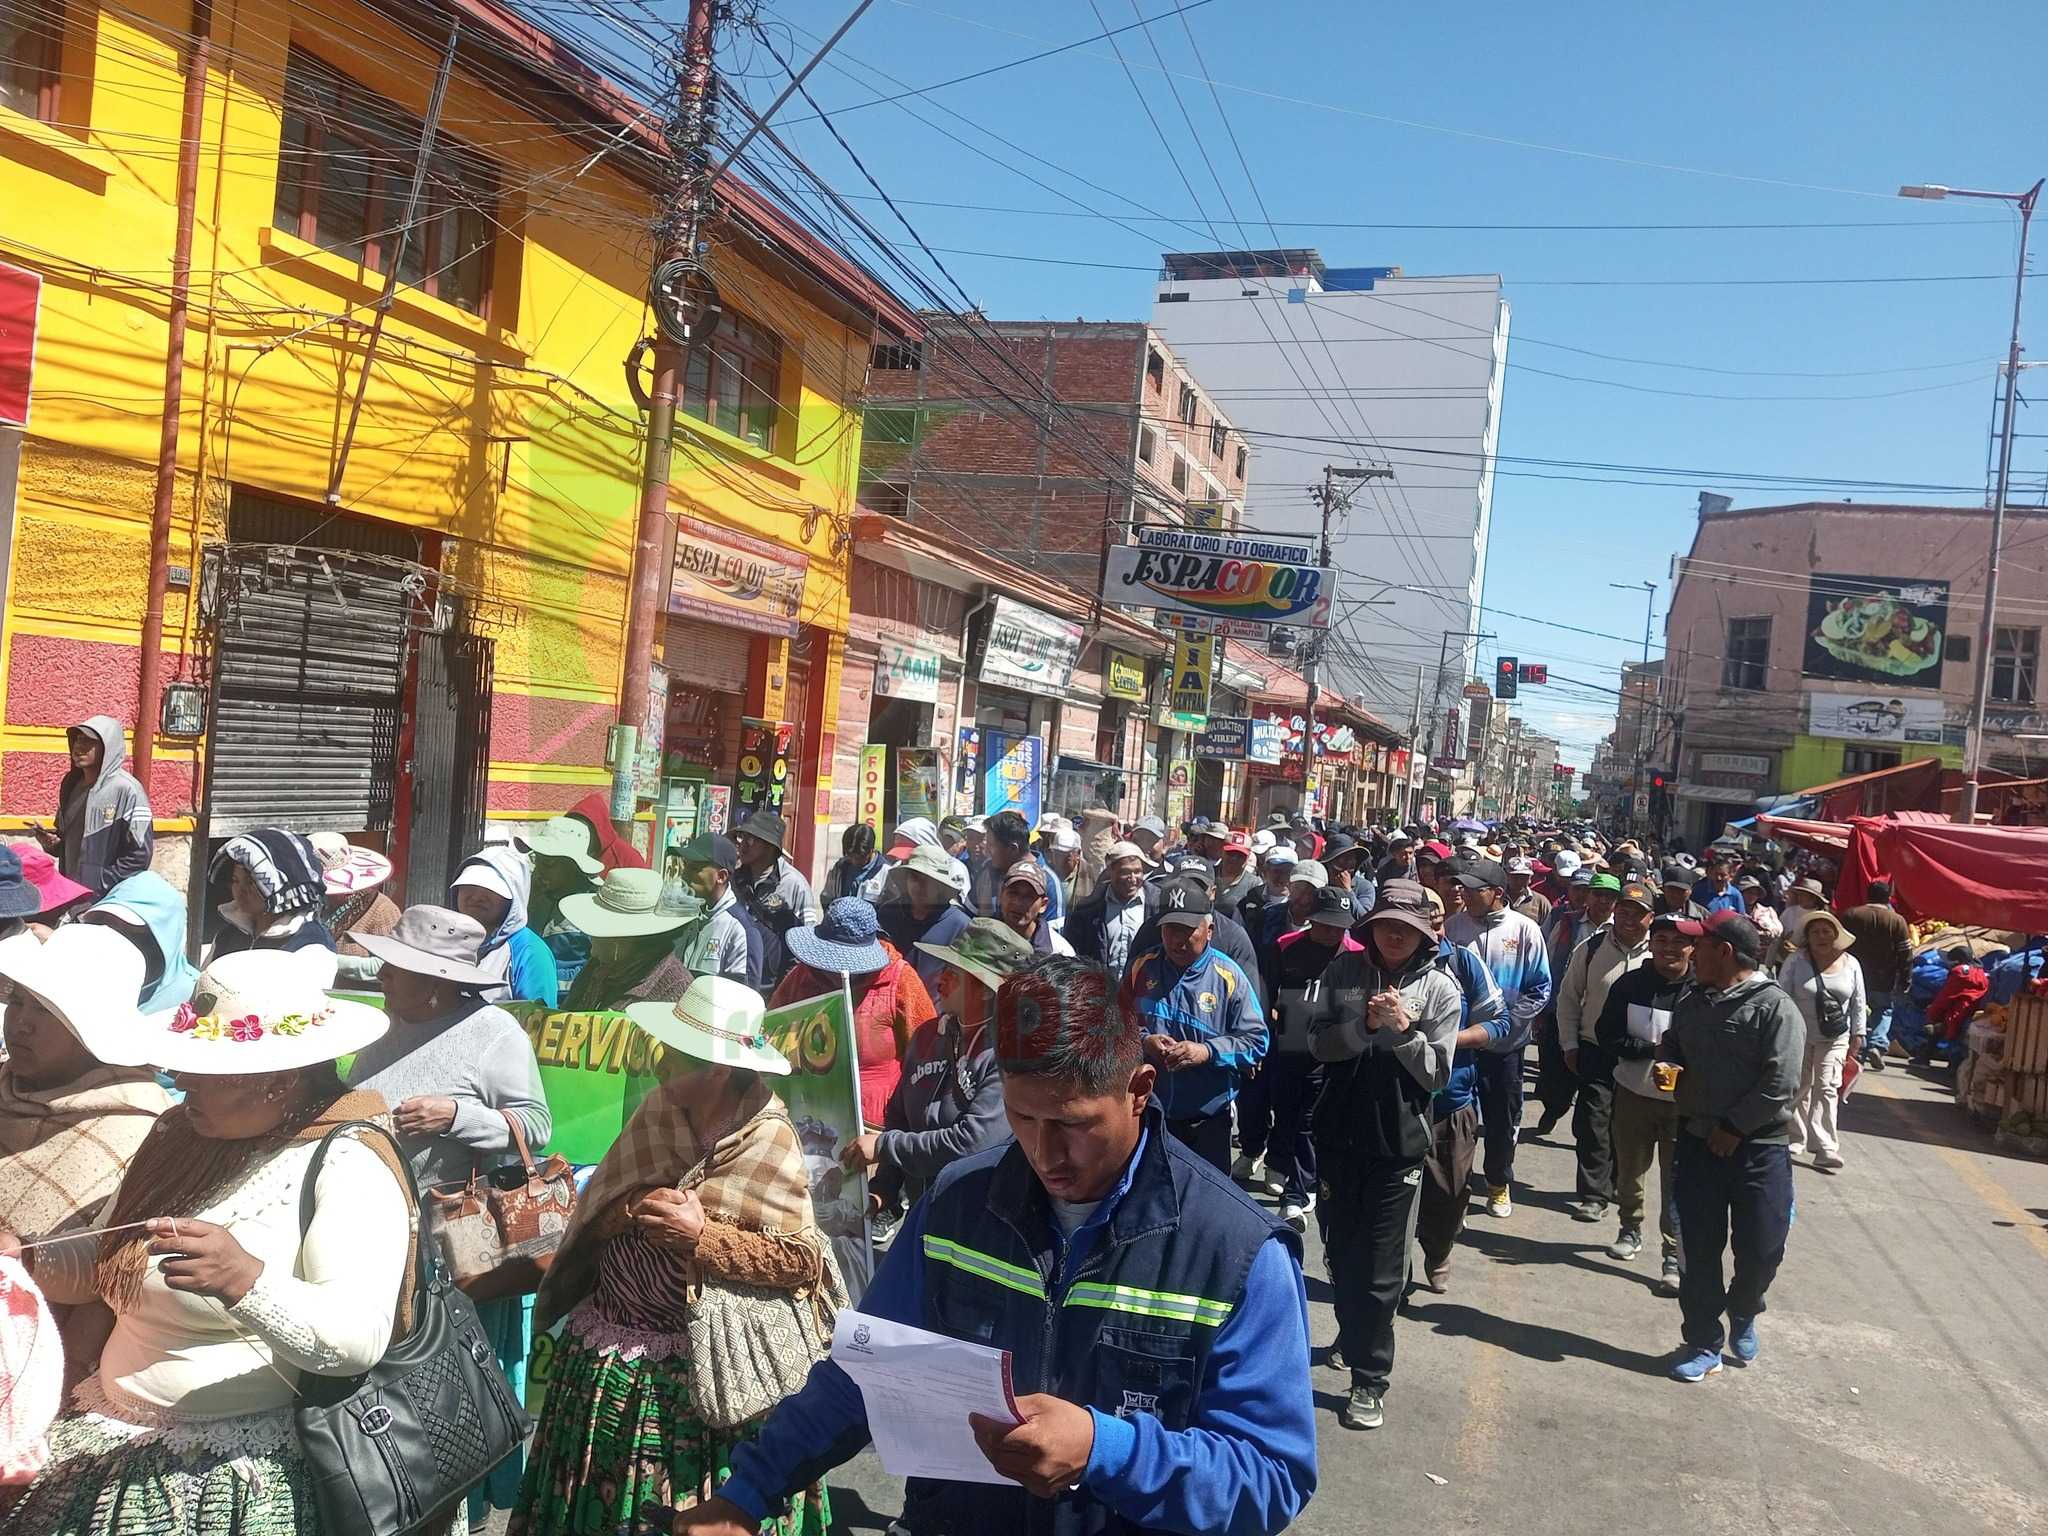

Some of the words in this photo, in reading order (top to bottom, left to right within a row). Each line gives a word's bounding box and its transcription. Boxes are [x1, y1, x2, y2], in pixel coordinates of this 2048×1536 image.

[1140, 530, 1220, 552] LABORATORIO
[1226, 540, 1309, 562] FOTOGRAFICO
[1312, 597, 1330, 626] 2
[891, 646, 937, 685] ZOOM
[865, 756, 878, 828] FOTOS
[1168, 888, 1186, 909] NY
[1303, 979, 1321, 1002] 11
